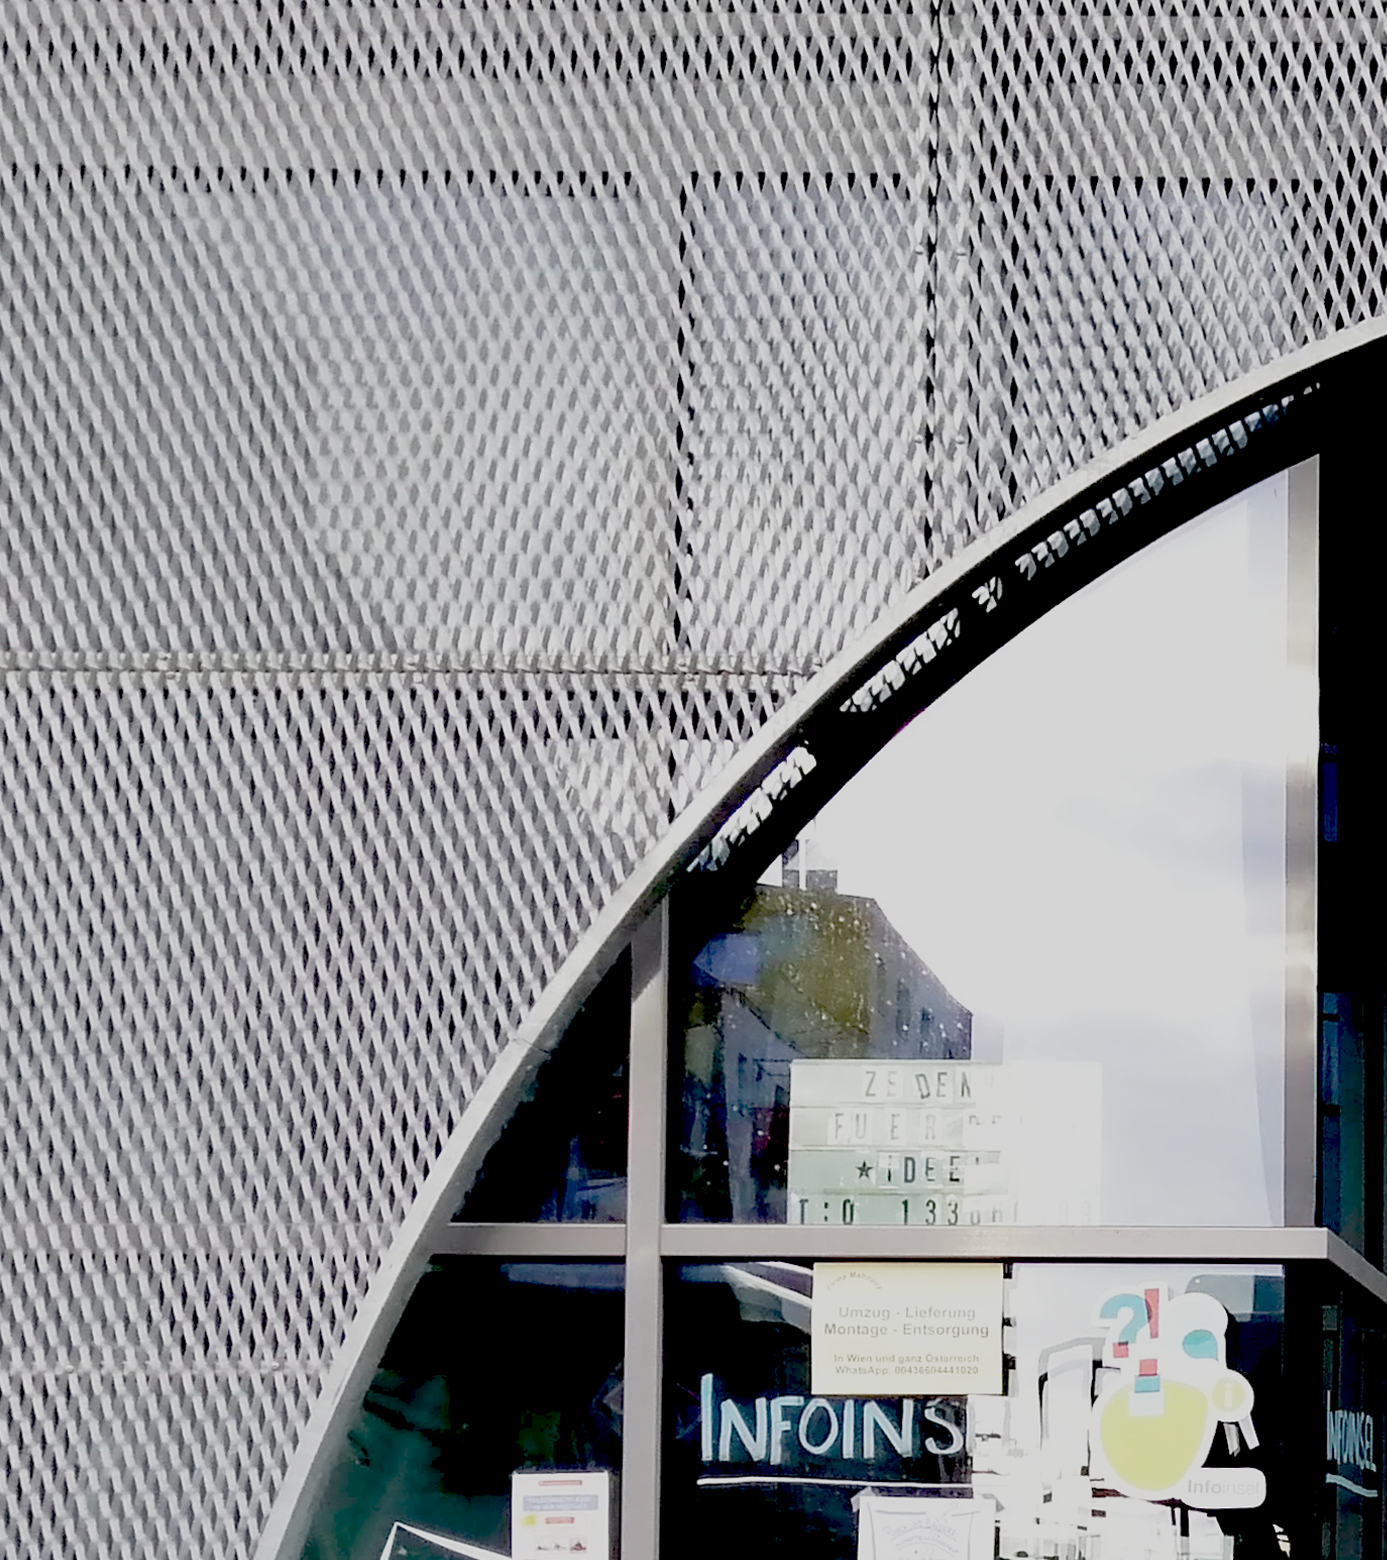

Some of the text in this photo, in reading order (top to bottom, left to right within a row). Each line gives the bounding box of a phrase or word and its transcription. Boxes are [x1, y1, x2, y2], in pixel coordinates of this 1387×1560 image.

[838, 1306, 891, 1321] Umzug
[905, 1306, 976, 1321] Lieferung
[824, 1322, 888, 1338] Montage
[903, 1322, 989, 1338] Entsorgung
[834, 1354, 844, 1363] In
[847, 1354, 872, 1363] Wien
[875, 1354, 896, 1363] und
[898, 1355, 922, 1365] ganz
[699, 1373, 967, 1464] INFOINS
[1187, 1479, 1260, 1495] Infoinsel
